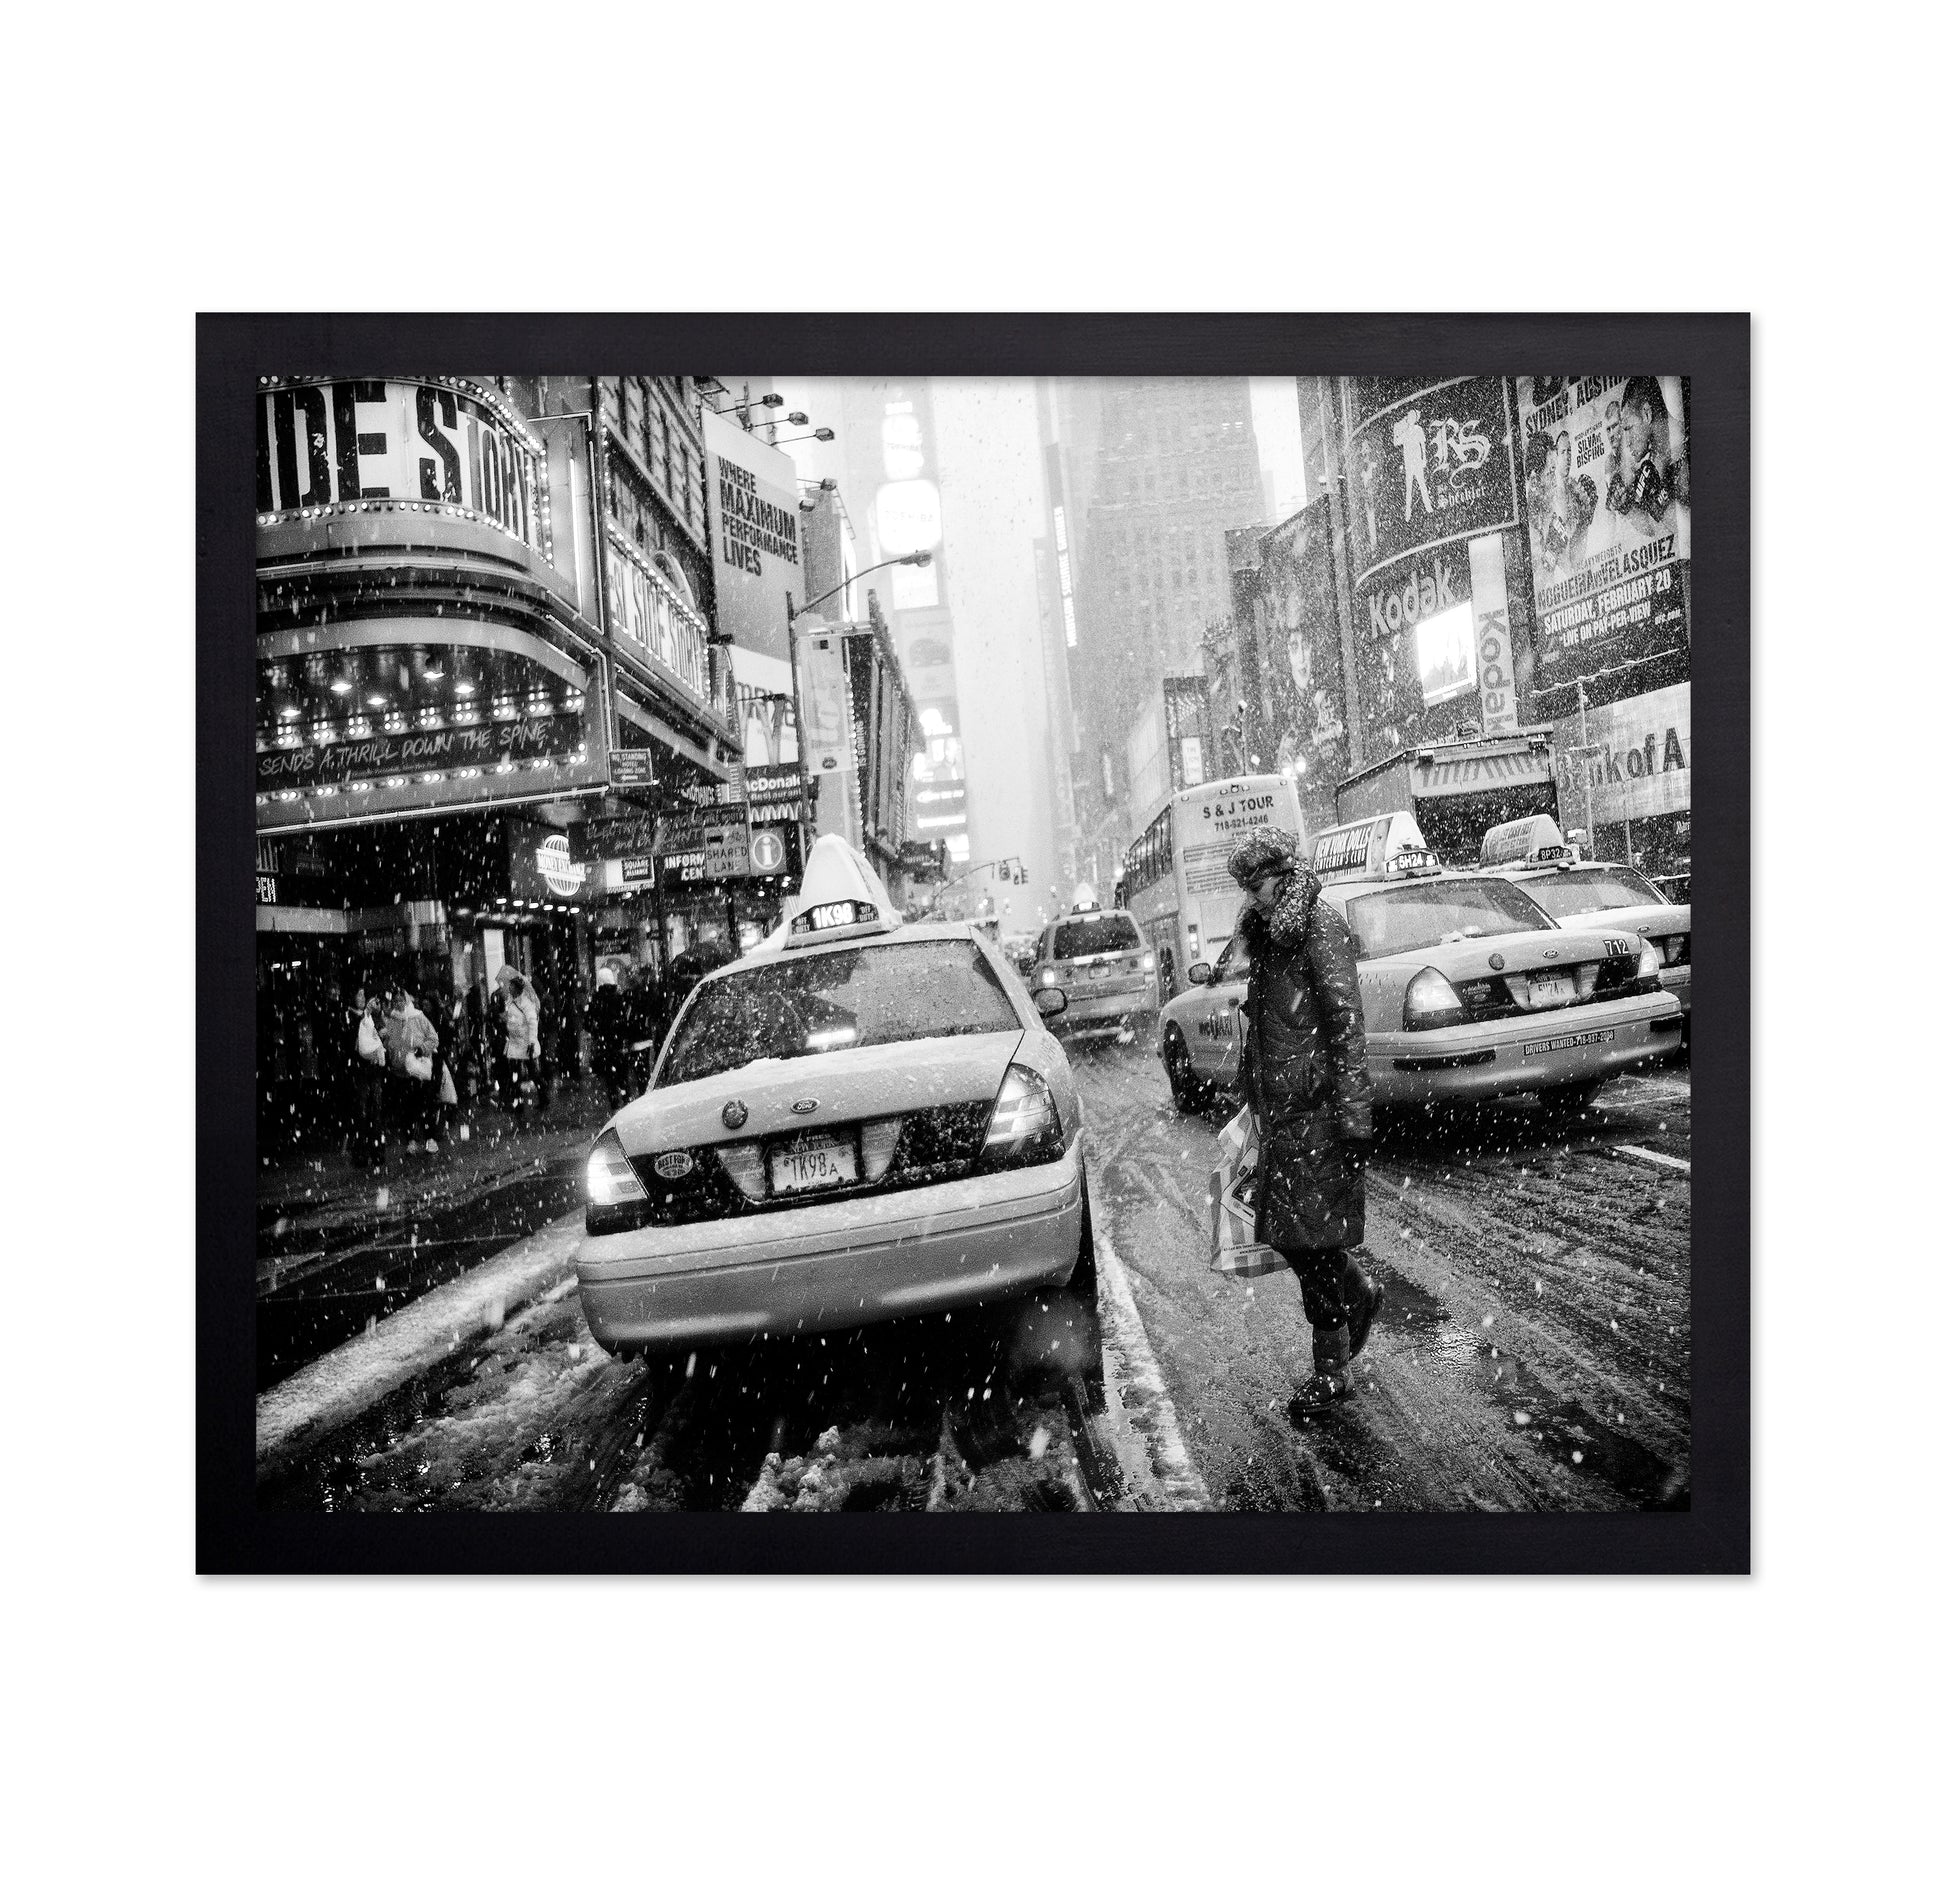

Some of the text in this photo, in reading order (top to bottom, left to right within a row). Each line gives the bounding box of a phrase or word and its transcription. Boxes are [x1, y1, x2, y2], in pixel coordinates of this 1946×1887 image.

[415, 385, 541, 547] STORY
[719, 456, 757, 493] WHERE
[720, 479, 796, 543] MAXIMUM
[721, 511, 799, 566] PERFORMANCE
[723, 536, 762, 577] LIVES
[1601, 534, 1675, 584] VELASQUEZ
[1368, 558, 1457, 639] Kodak
[1544, 569, 1671, 635] SATURDAY, FEBRUARY 20
[1580, 621, 1592, 640] ON
[1478, 609, 1515, 732] Kodak
[259, 750, 315, 776] SENDS
[319, 748, 333, 775] A
[337, 743, 398, 767] THRILL
[402, 733, 453, 758] DOWN
[460, 729, 492, 750] THE
[1627, 733, 1656, 779] of
[1203, 796, 1274, 819] S & J TOUR
[707, 846, 747, 860] SHARED
[1400, 853, 1422, 869] 5H24
[812, 902, 853, 929] 1K98
[1606, 938, 1629, 956] 712
[1525, 1042, 1549, 1056] DRIVERS
